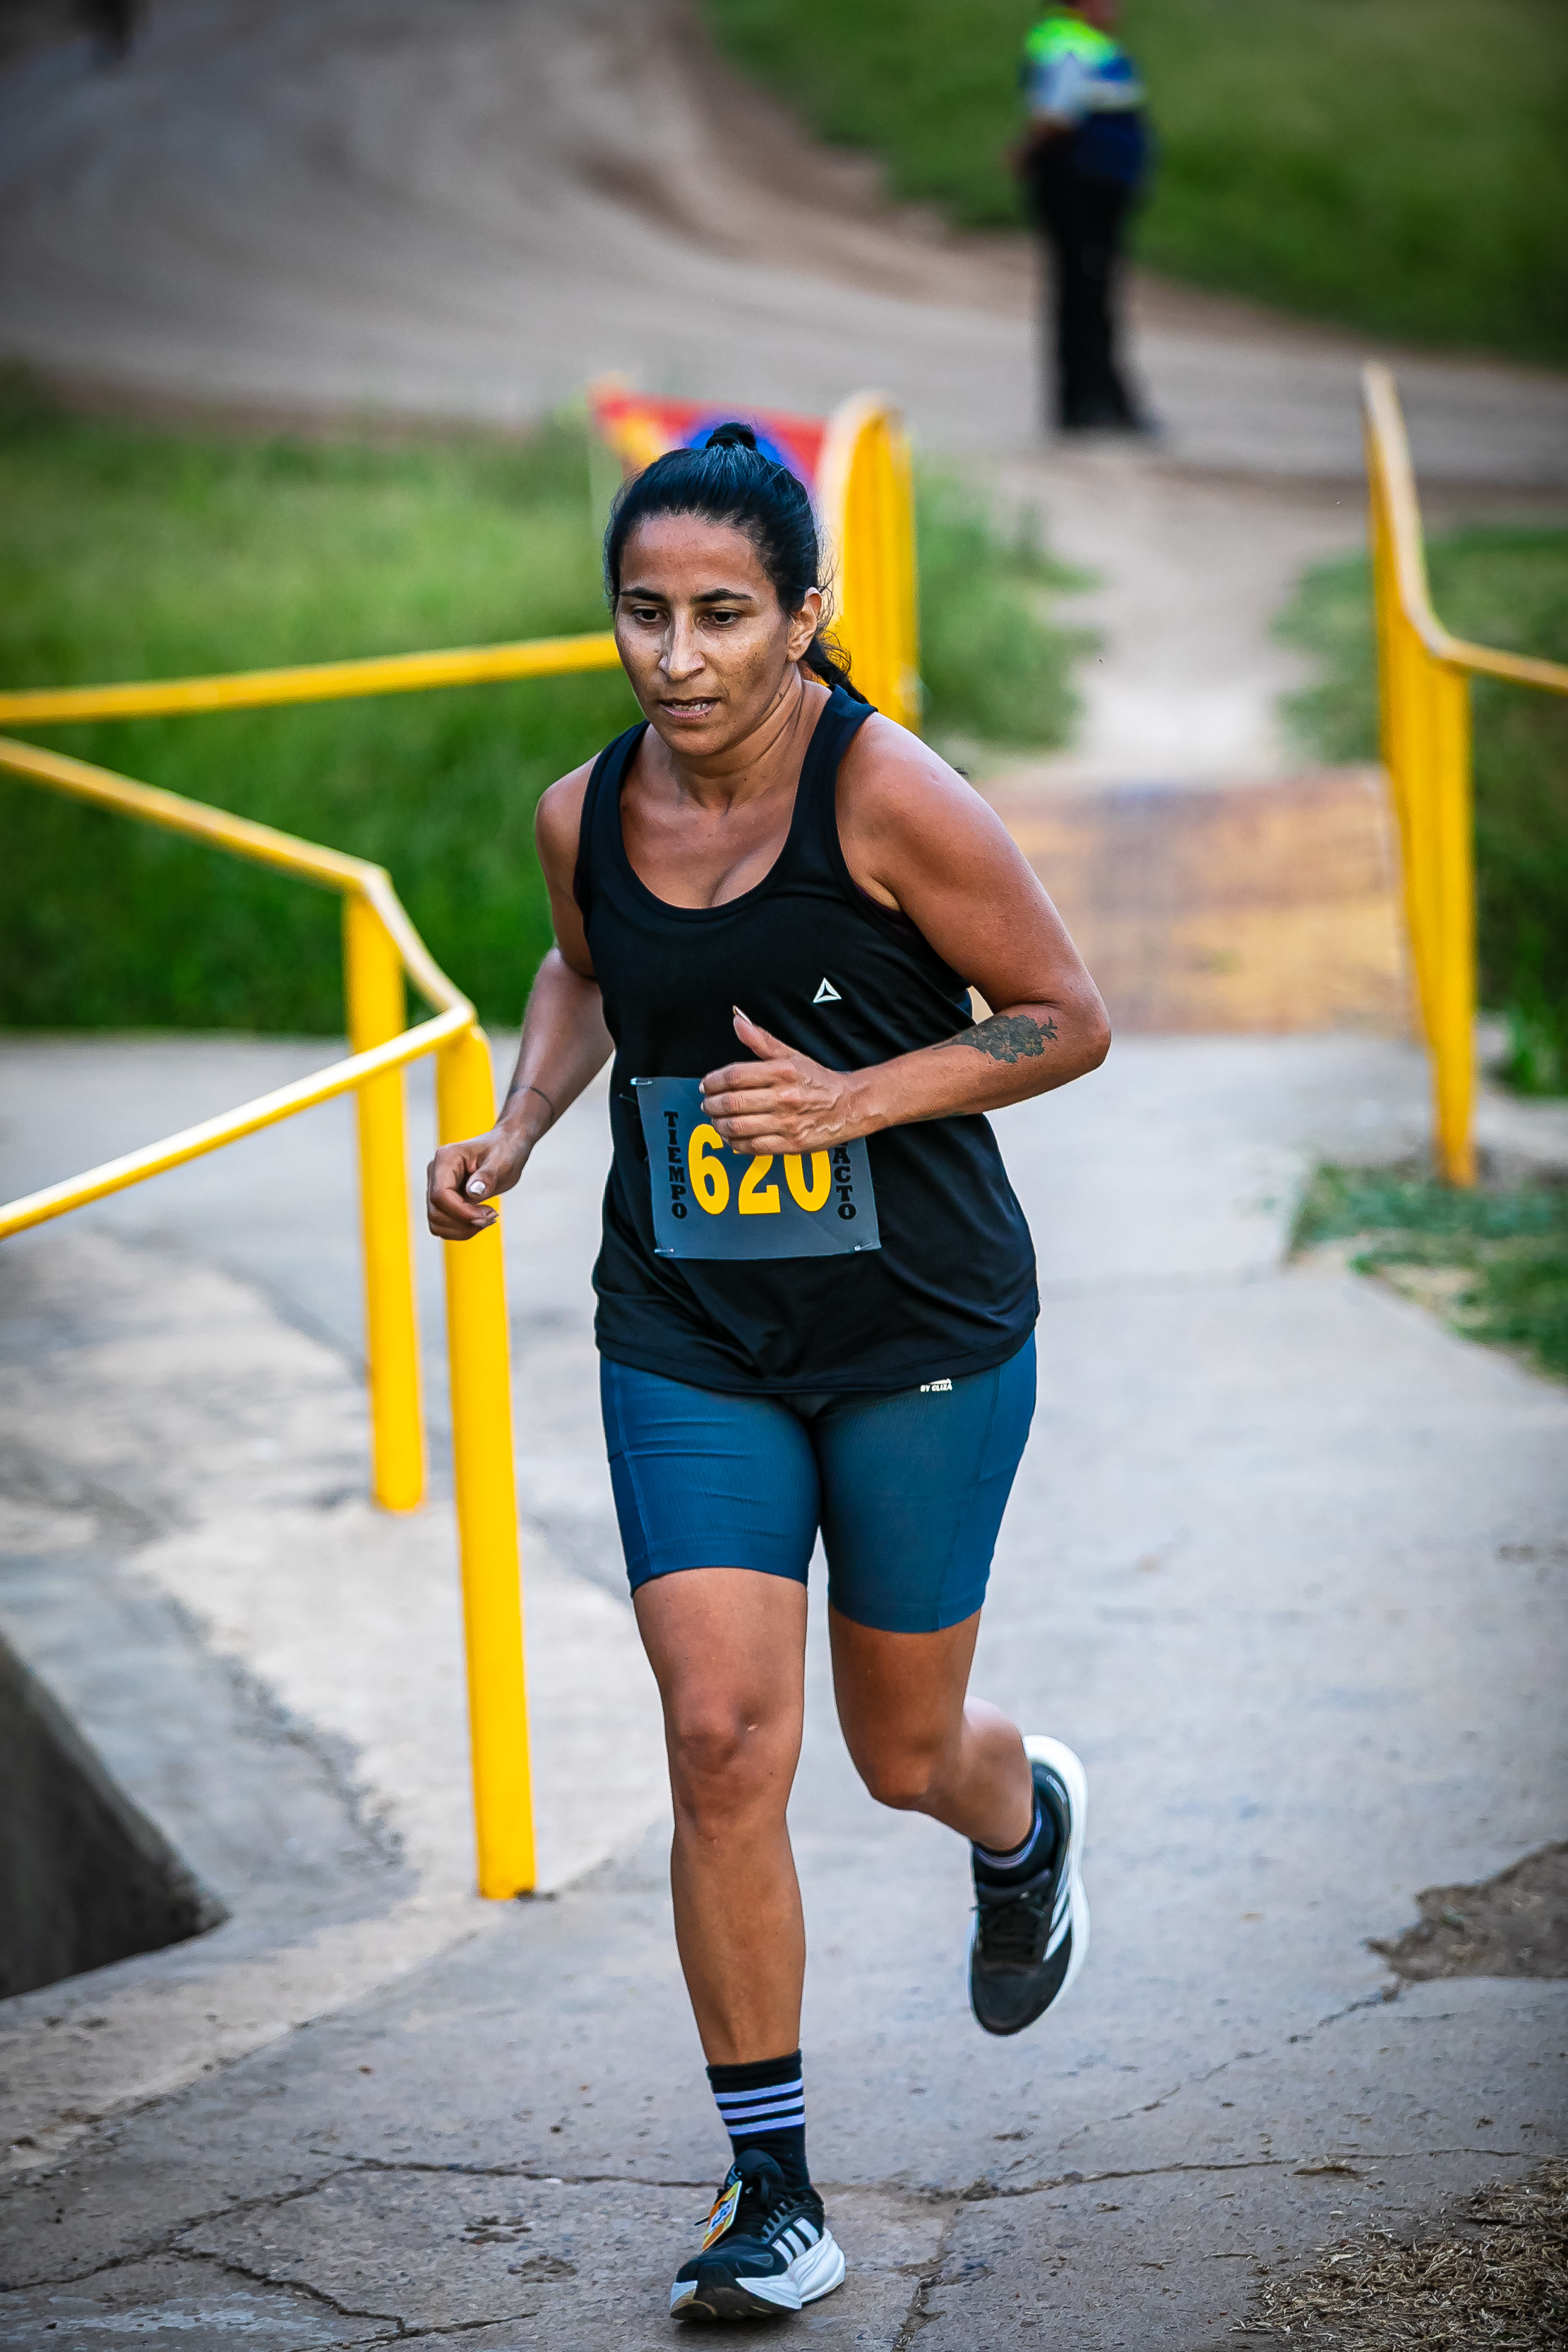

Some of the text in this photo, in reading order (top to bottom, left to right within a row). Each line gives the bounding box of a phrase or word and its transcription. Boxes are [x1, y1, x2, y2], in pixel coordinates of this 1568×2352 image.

[664, 1110, 688, 1219] TIEMPO
[688, 1123, 832, 1215] 620
[832, 1142, 857, 1220] ACTO
